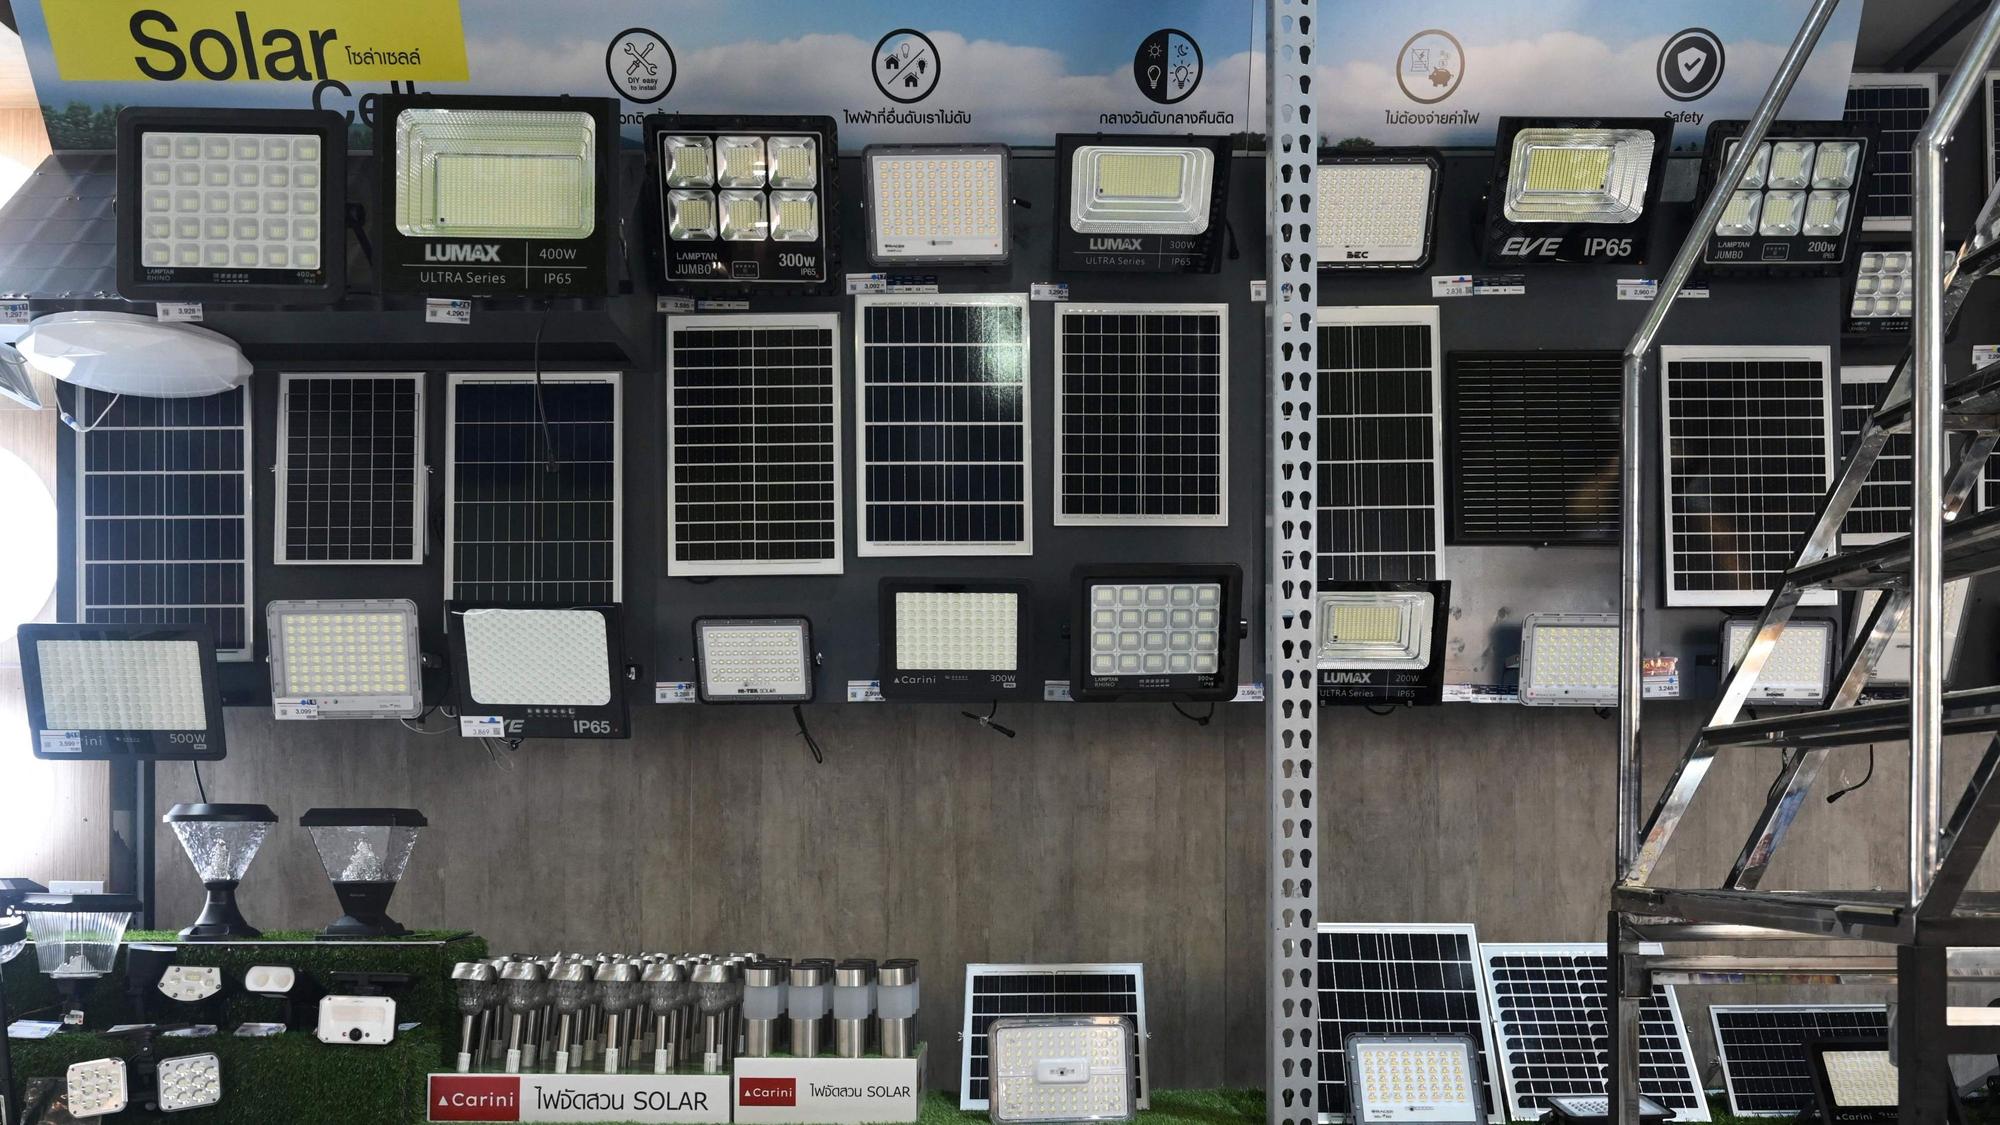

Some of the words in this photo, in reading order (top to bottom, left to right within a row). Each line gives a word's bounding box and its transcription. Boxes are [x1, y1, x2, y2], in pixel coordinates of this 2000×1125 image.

[129, 9, 337, 81] Solar
[345, 45, 421, 65] โซล่าเซลล์
[843, 107, 972, 124] ไฟฟ้าที่อื่นดับเราไม่ดับ
[1100, 110, 1234, 124] กลางวันดับกลางคืนติด
[1385, 110, 1480, 125] ไม่ต้องจ่ายค่าไฟ
[1664, 110, 1704, 126] Safety
[1089, 238, 1142, 251] LUMAX
[1169, 240, 1196, 250] 300W
[1501, 237, 1563, 256] EVE
[1584, 238, 1632, 256] IP65
[1717, 241, 1750, 249] LAMPTAN
[425, 244, 500, 262] LUMAX
[539, 248, 577, 260] 400W
[676, 252, 718, 261] LAMPTAN
[1715, 250, 1744, 260] JUMBO
[1085, 257, 1115, 265] ULTRA
[1118, 257, 1145, 266] Series
[1171, 257, 1191, 266] IP65
[675, 264, 712, 275] JUMBO
[800, 268, 816, 277] IP65
[420, 271, 463, 283] ULTRA
[466, 272, 506, 284] Series
[544, 273, 572, 285] IP65
[902, 676, 936, 684] Carini
[1323, 673, 1370, 683] LUMAX
[1396, 674, 1419, 682] 200W
[1320, 689, 1346, 697] ULTRA
[1349, 689, 1374, 697] Series
[1398, 690, 1415, 698] IP65
[573, 720, 611, 734] IP65
[169, 734, 206, 743] 500W
[752, 1087, 793, 1097] Carini
[809, 1083, 862, 1098] ไฟจัดสวน
[867, 1085, 911, 1098] SOLAR
[452, 1092, 514, 1107] Carini
[534, 1086, 624, 1110] ไฟจัดสวน
[633, 1091, 709, 1110] SOLAR
